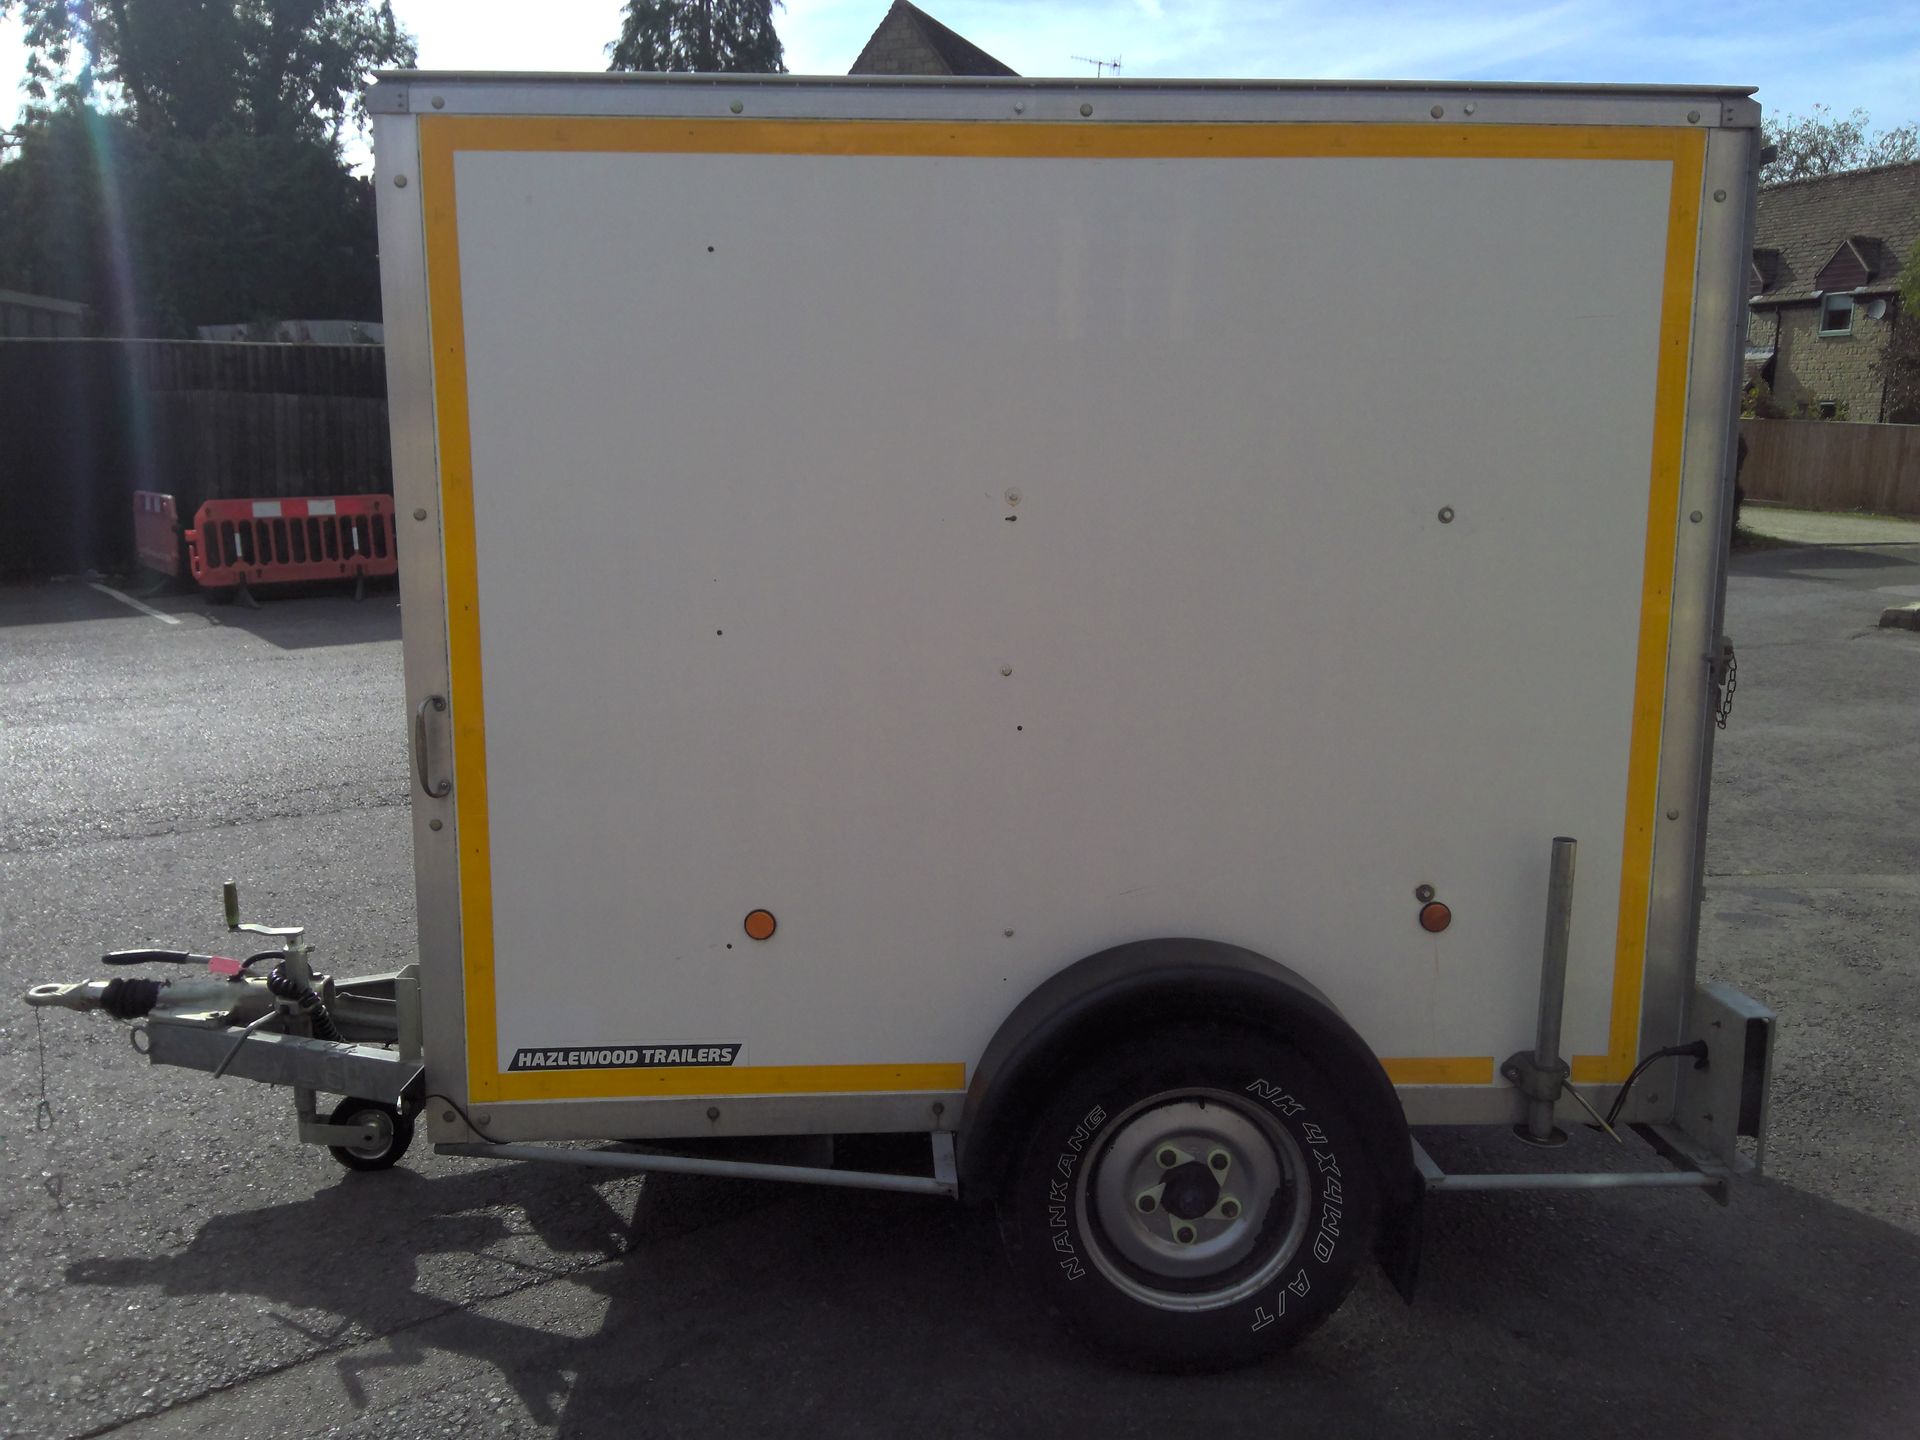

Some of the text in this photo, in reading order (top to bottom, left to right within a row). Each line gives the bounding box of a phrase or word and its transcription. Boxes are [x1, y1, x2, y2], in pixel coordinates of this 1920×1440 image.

[518, 1047, 733, 1067] HAZLEWOOD TRAILERS
[1049, 1105, 1107, 1280] NANKANG
[1246, 1078, 1343, 1331] NK 4X4WD A/T
